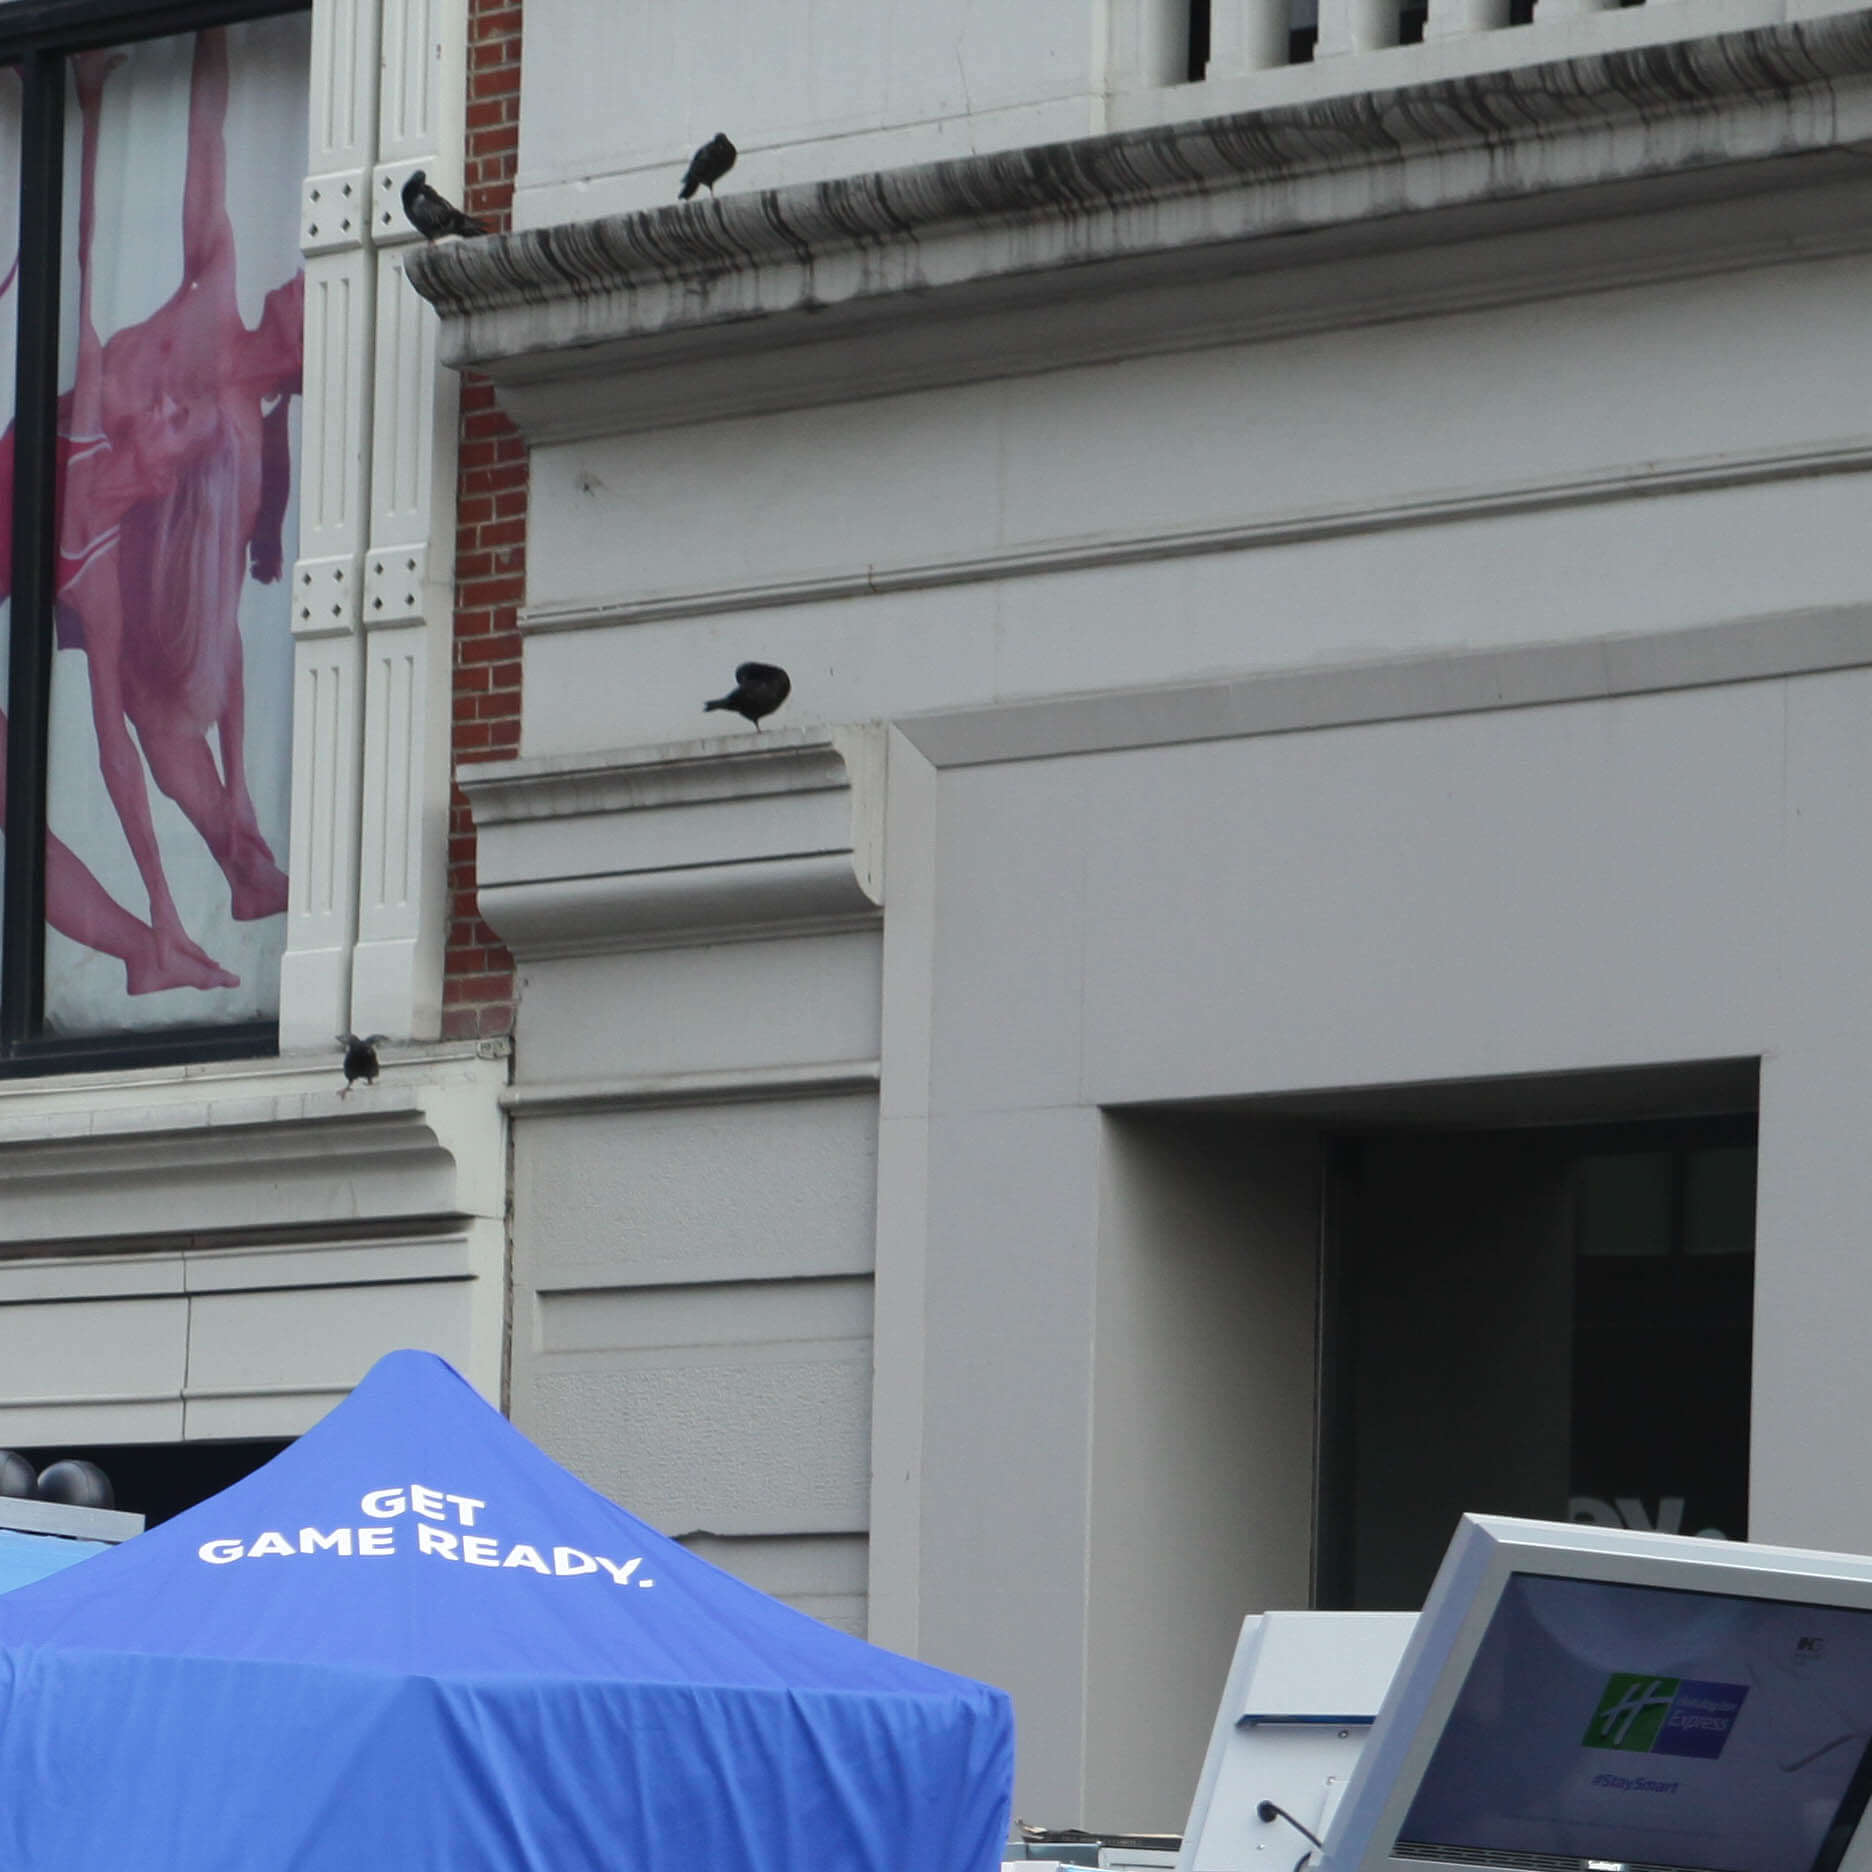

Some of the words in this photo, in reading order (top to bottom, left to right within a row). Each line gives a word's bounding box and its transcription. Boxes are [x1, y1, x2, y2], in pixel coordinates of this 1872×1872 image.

[360, 1484, 485, 1527] GET
[197, 1526, 396, 1565] GAME
[416, 1523, 655, 1589] READY.
